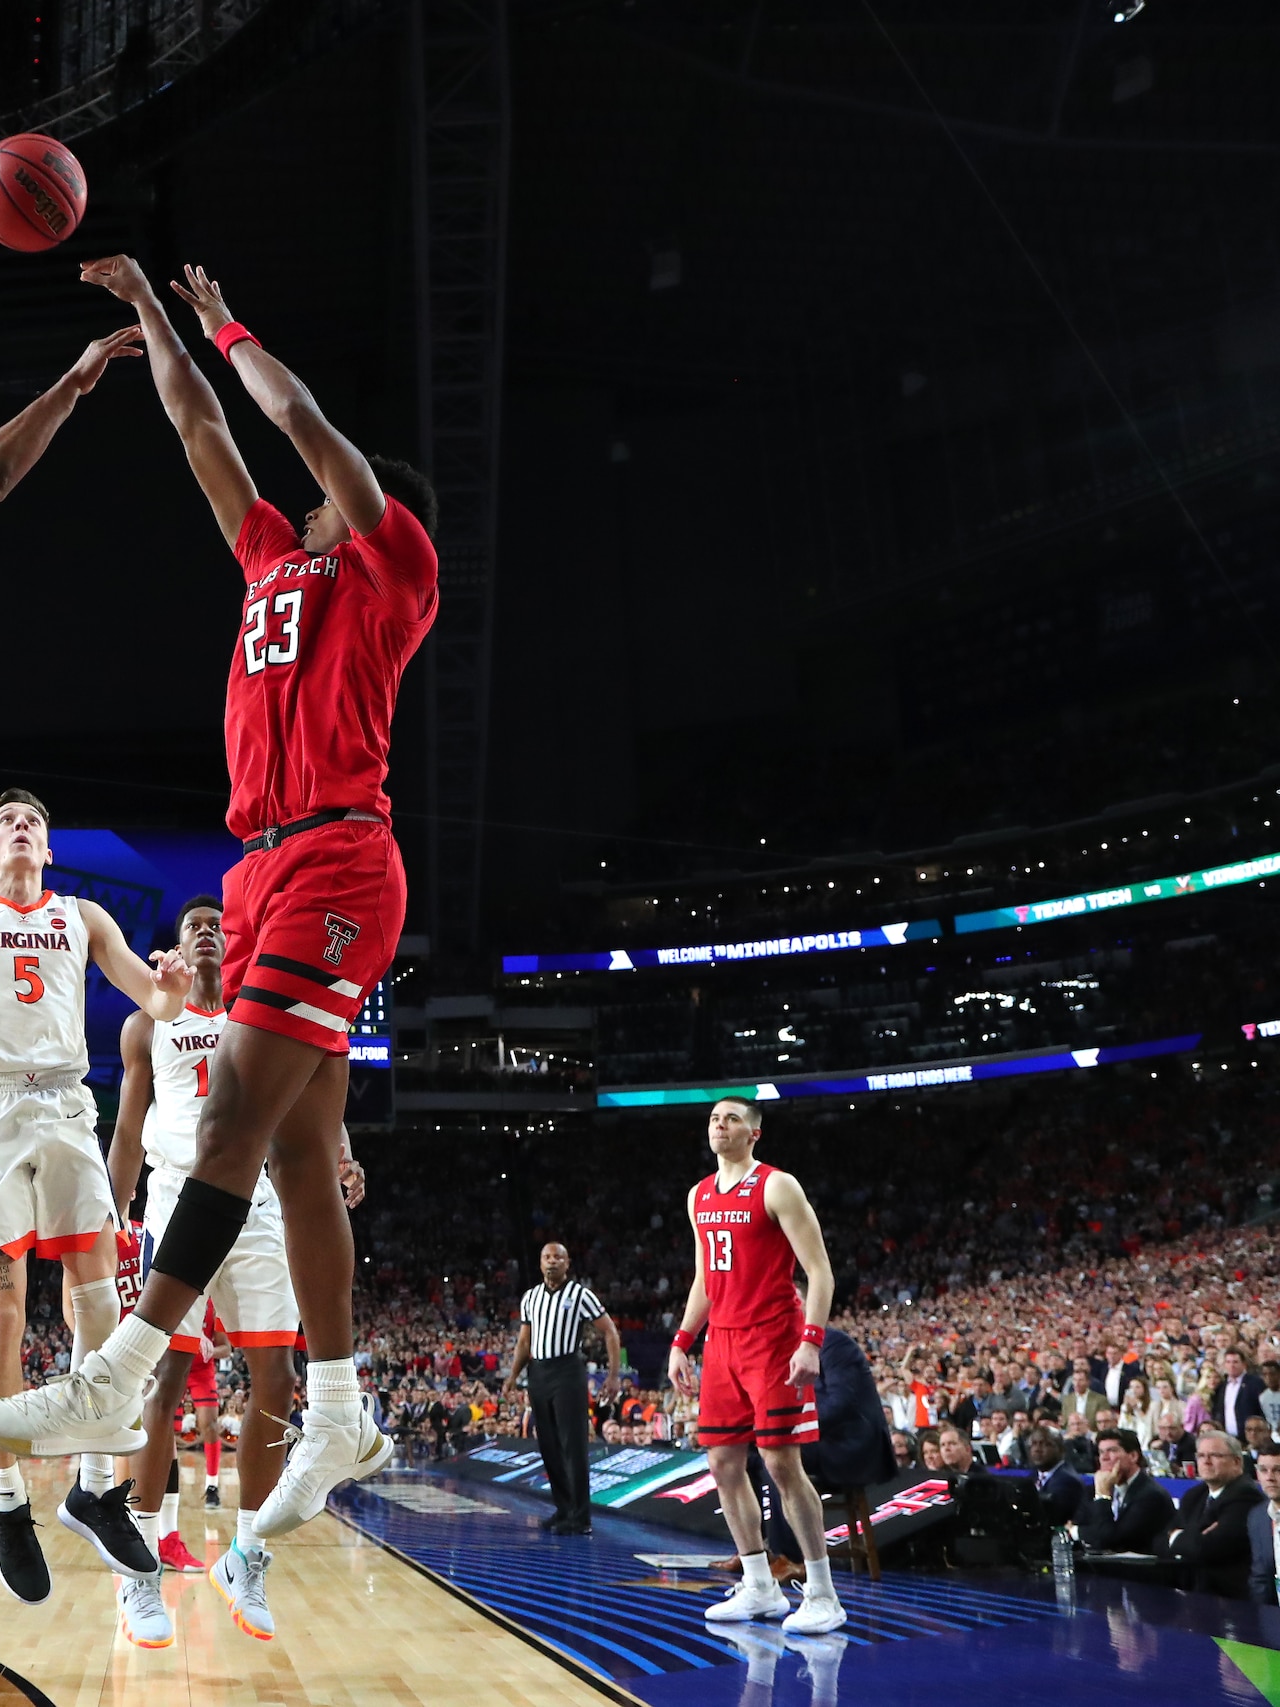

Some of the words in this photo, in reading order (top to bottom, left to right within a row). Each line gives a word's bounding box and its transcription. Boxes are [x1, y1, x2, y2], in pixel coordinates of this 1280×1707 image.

[283, 557, 339, 578] TECH
[242, 588, 303, 677] 23
[1032, 897, 1086, 920] TEXAS
[1086, 888, 1132, 910] TECH
[657, 946, 713, 964] WELCOME
[714, 945, 726, 957] TO
[726, 931, 862, 960] MINNEAPOLIS
[13, 955, 45, 1004] 5
[696, 1211, 722, 1224] TEXAS
[724, 1210, 751, 1224] TECH
[706, 1230, 733, 1271] 13
